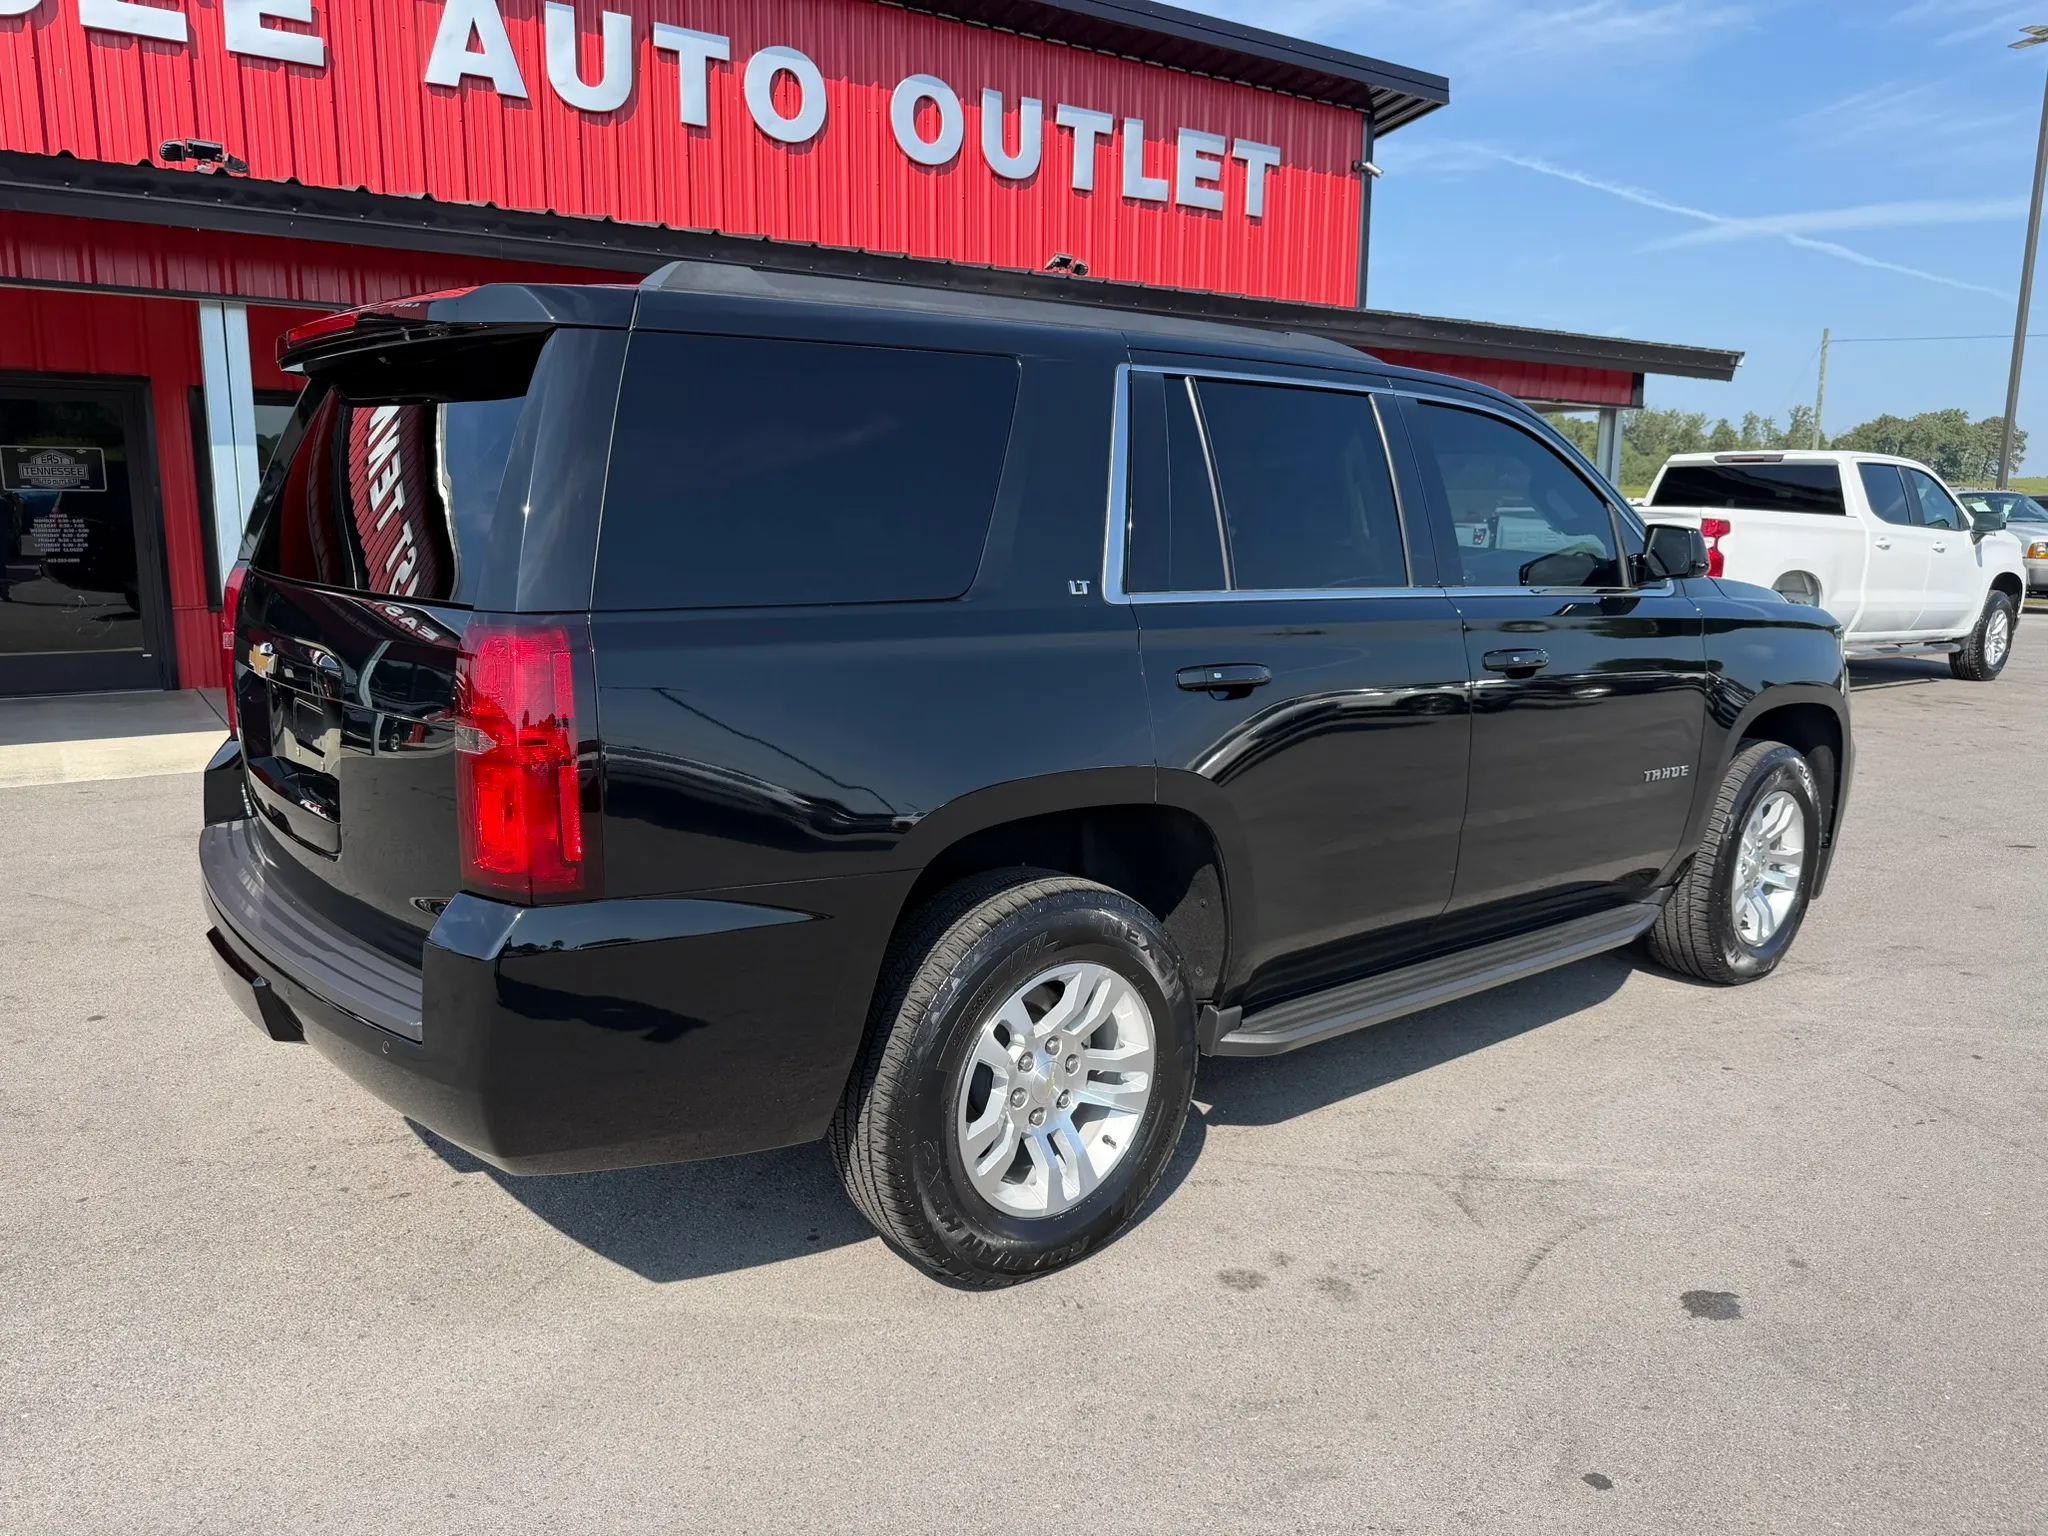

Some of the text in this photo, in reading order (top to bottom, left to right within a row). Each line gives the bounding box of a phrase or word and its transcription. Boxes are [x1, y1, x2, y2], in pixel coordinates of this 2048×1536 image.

[425, 0, 827, 143] AUTO
[890, 73, 1280, 218] OUTLET
[25, 467, 84, 476] TENNESSEE
[1069, 580, 1090, 595] LT
[1644, 765, 1689, 782] TAHOE
